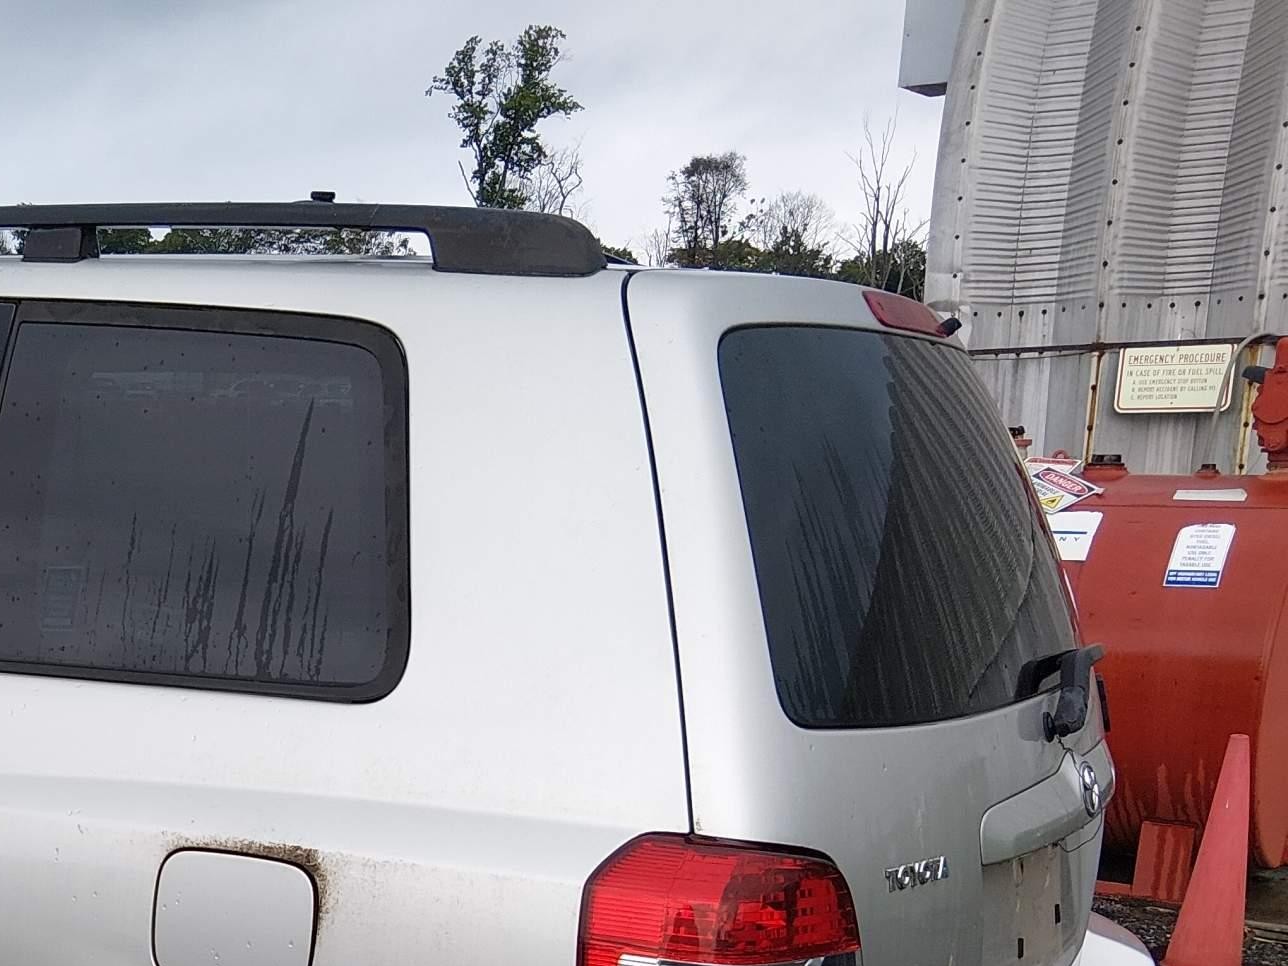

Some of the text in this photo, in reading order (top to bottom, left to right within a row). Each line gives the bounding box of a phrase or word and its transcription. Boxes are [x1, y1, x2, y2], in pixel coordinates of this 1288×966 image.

[1128, 352, 1227, 364] EMERGENCY PROCEDURE
[1045, 473, 1082, 493] DANGER
[884, 854, 949, 893] TOYOTA
